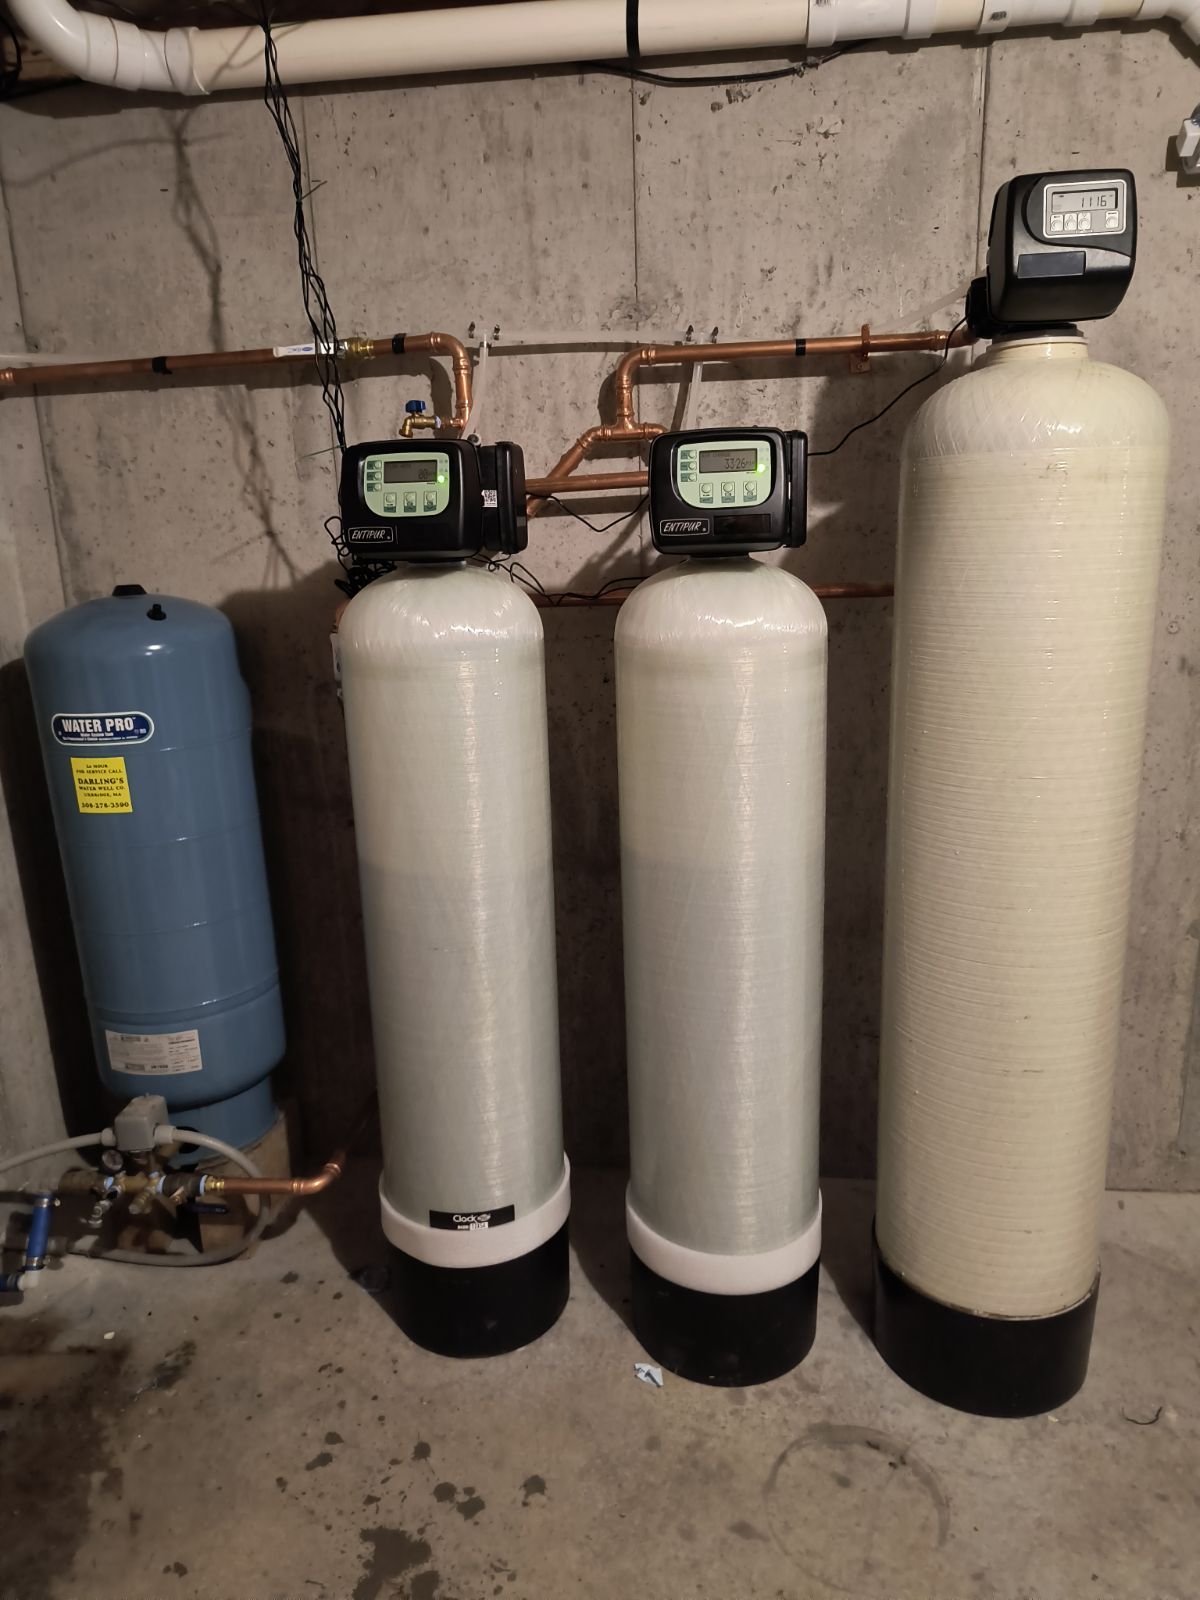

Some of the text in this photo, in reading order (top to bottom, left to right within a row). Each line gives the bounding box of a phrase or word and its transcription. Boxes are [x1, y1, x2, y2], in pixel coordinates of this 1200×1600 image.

[663, 521, 702, 532] ENTIPUR
[351, 530, 386, 540] ENTIPUR
[62, 719, 102, 732] WATER
[77, 777, 125, 785] DARLING'S
